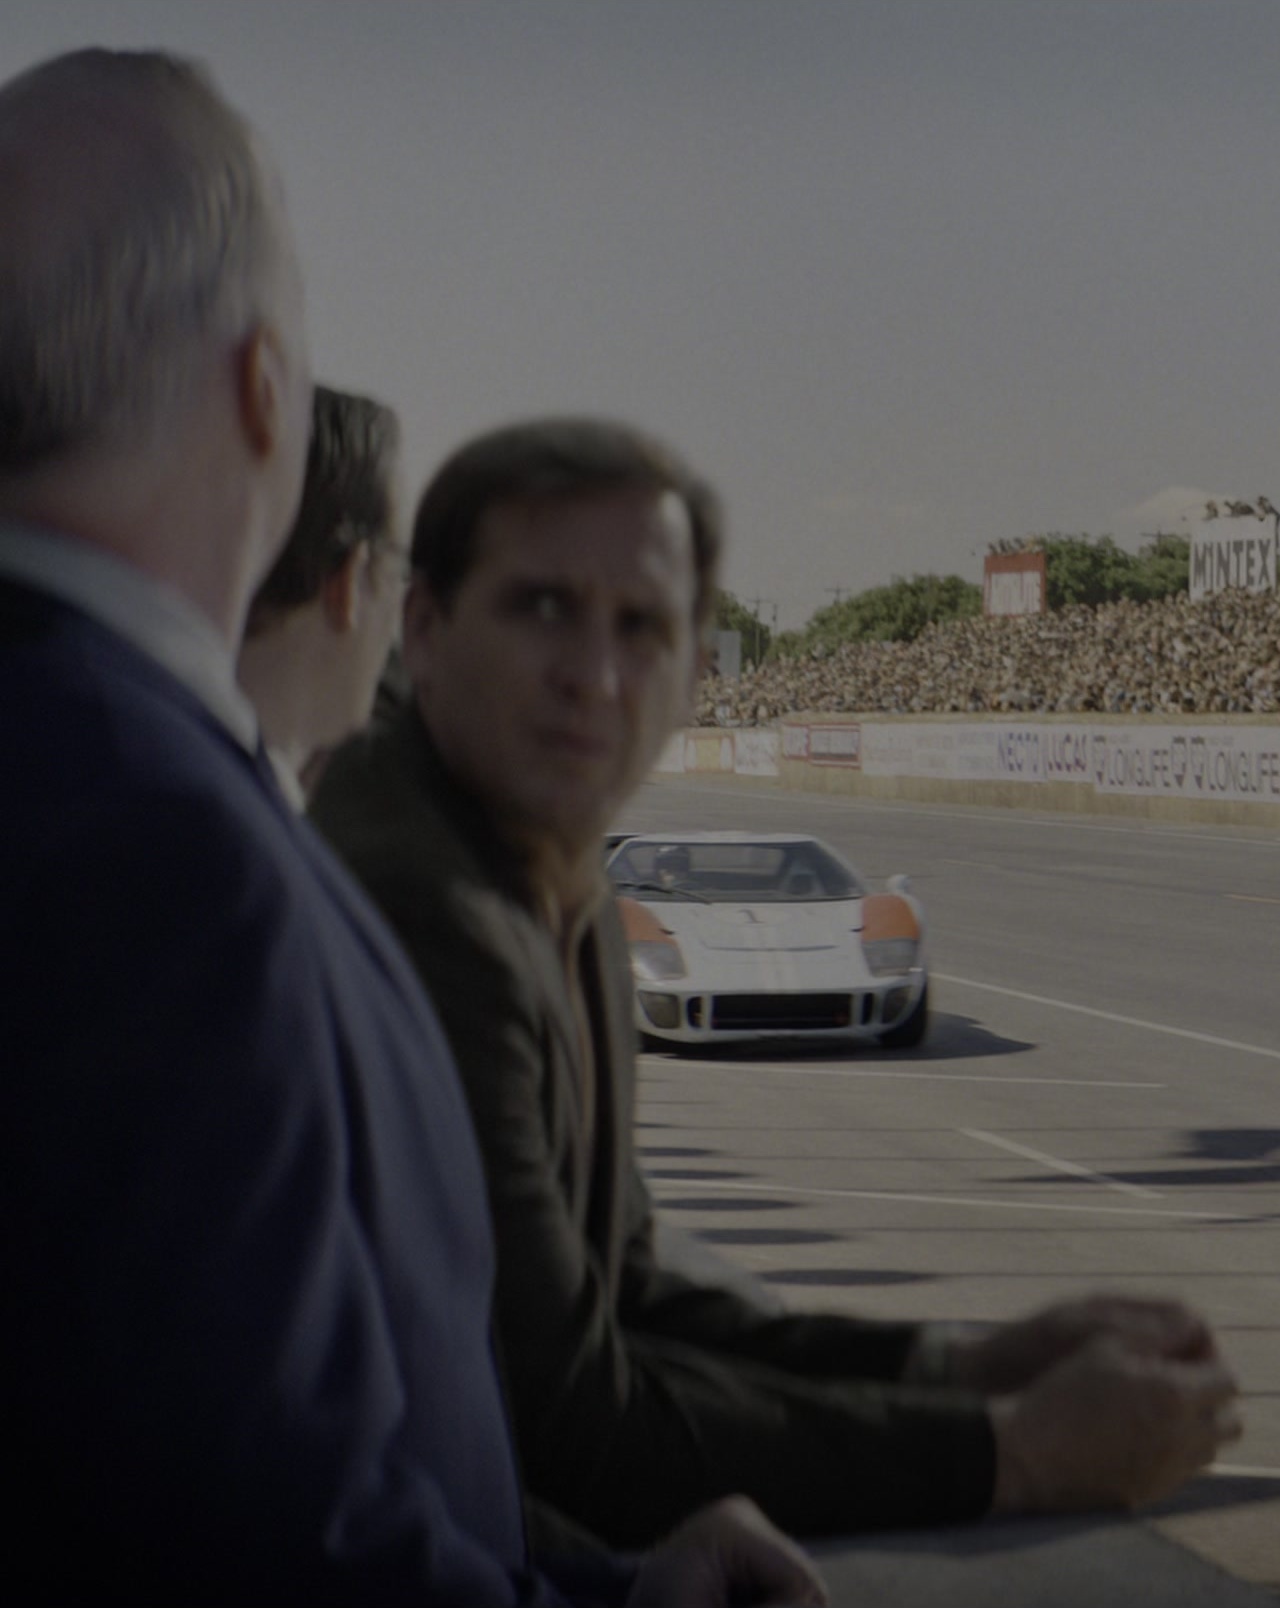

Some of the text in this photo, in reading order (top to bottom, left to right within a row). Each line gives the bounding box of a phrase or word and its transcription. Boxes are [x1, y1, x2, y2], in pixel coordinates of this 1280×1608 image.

[1193, 538, 1272, 590] MINTEX
[1108, 748, 1171, 788] LONGLIFE
[1208, 751, 1280, 795] LONGLIFE
[738, 908, 765, 924] 1
